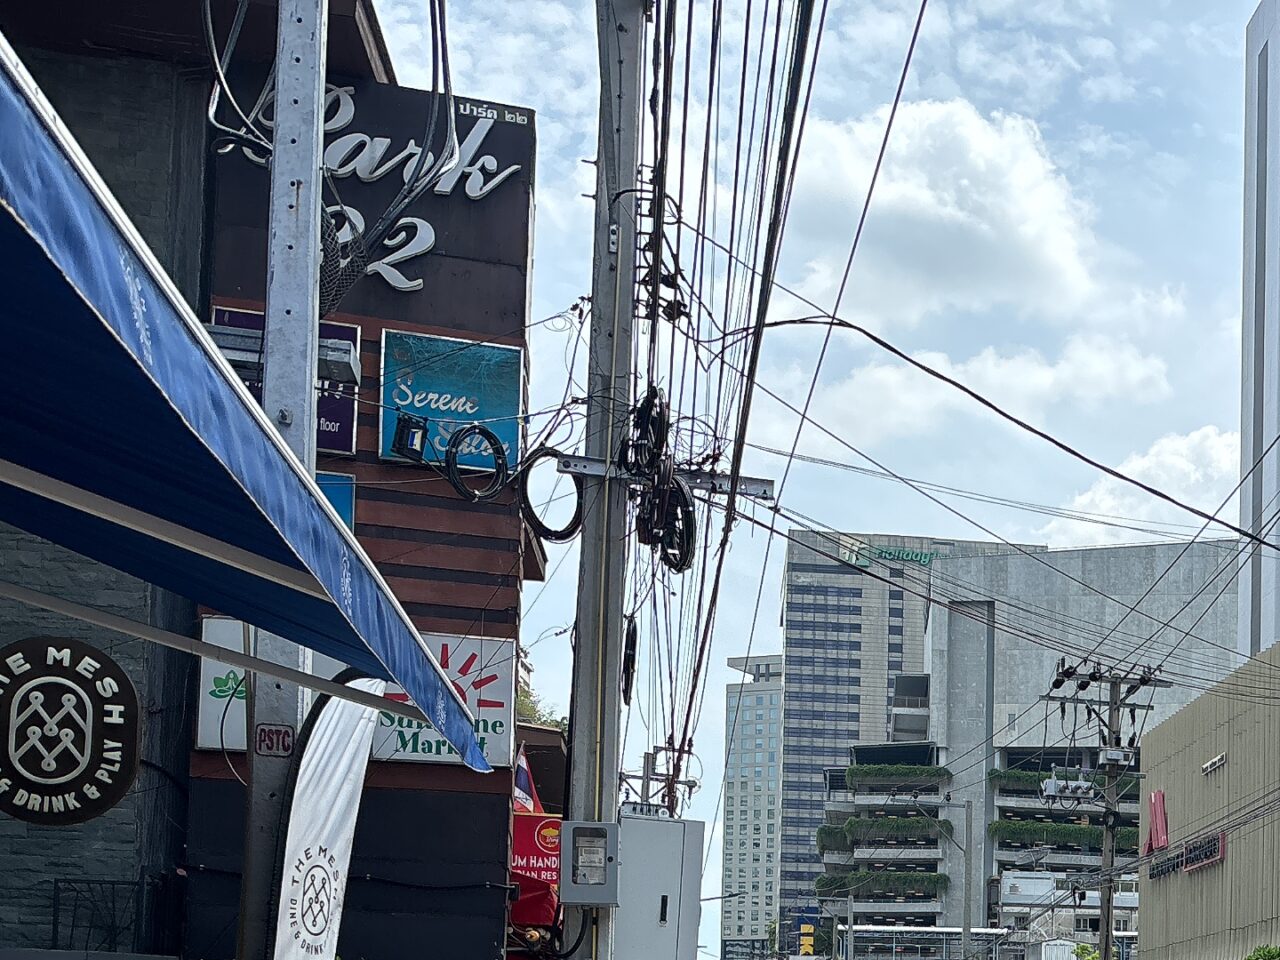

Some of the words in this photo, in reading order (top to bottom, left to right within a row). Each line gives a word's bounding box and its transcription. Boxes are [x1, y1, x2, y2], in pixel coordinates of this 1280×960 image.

[319, 416, 341, 433] floor
[45, 645, 126, 725] MESH
[257, 731, 293, 752] PSTC
[12, 788, 82, 814] DRINK
[94, 738, 124, 784] PLAY
[289, 897, 299, 929] DINE
